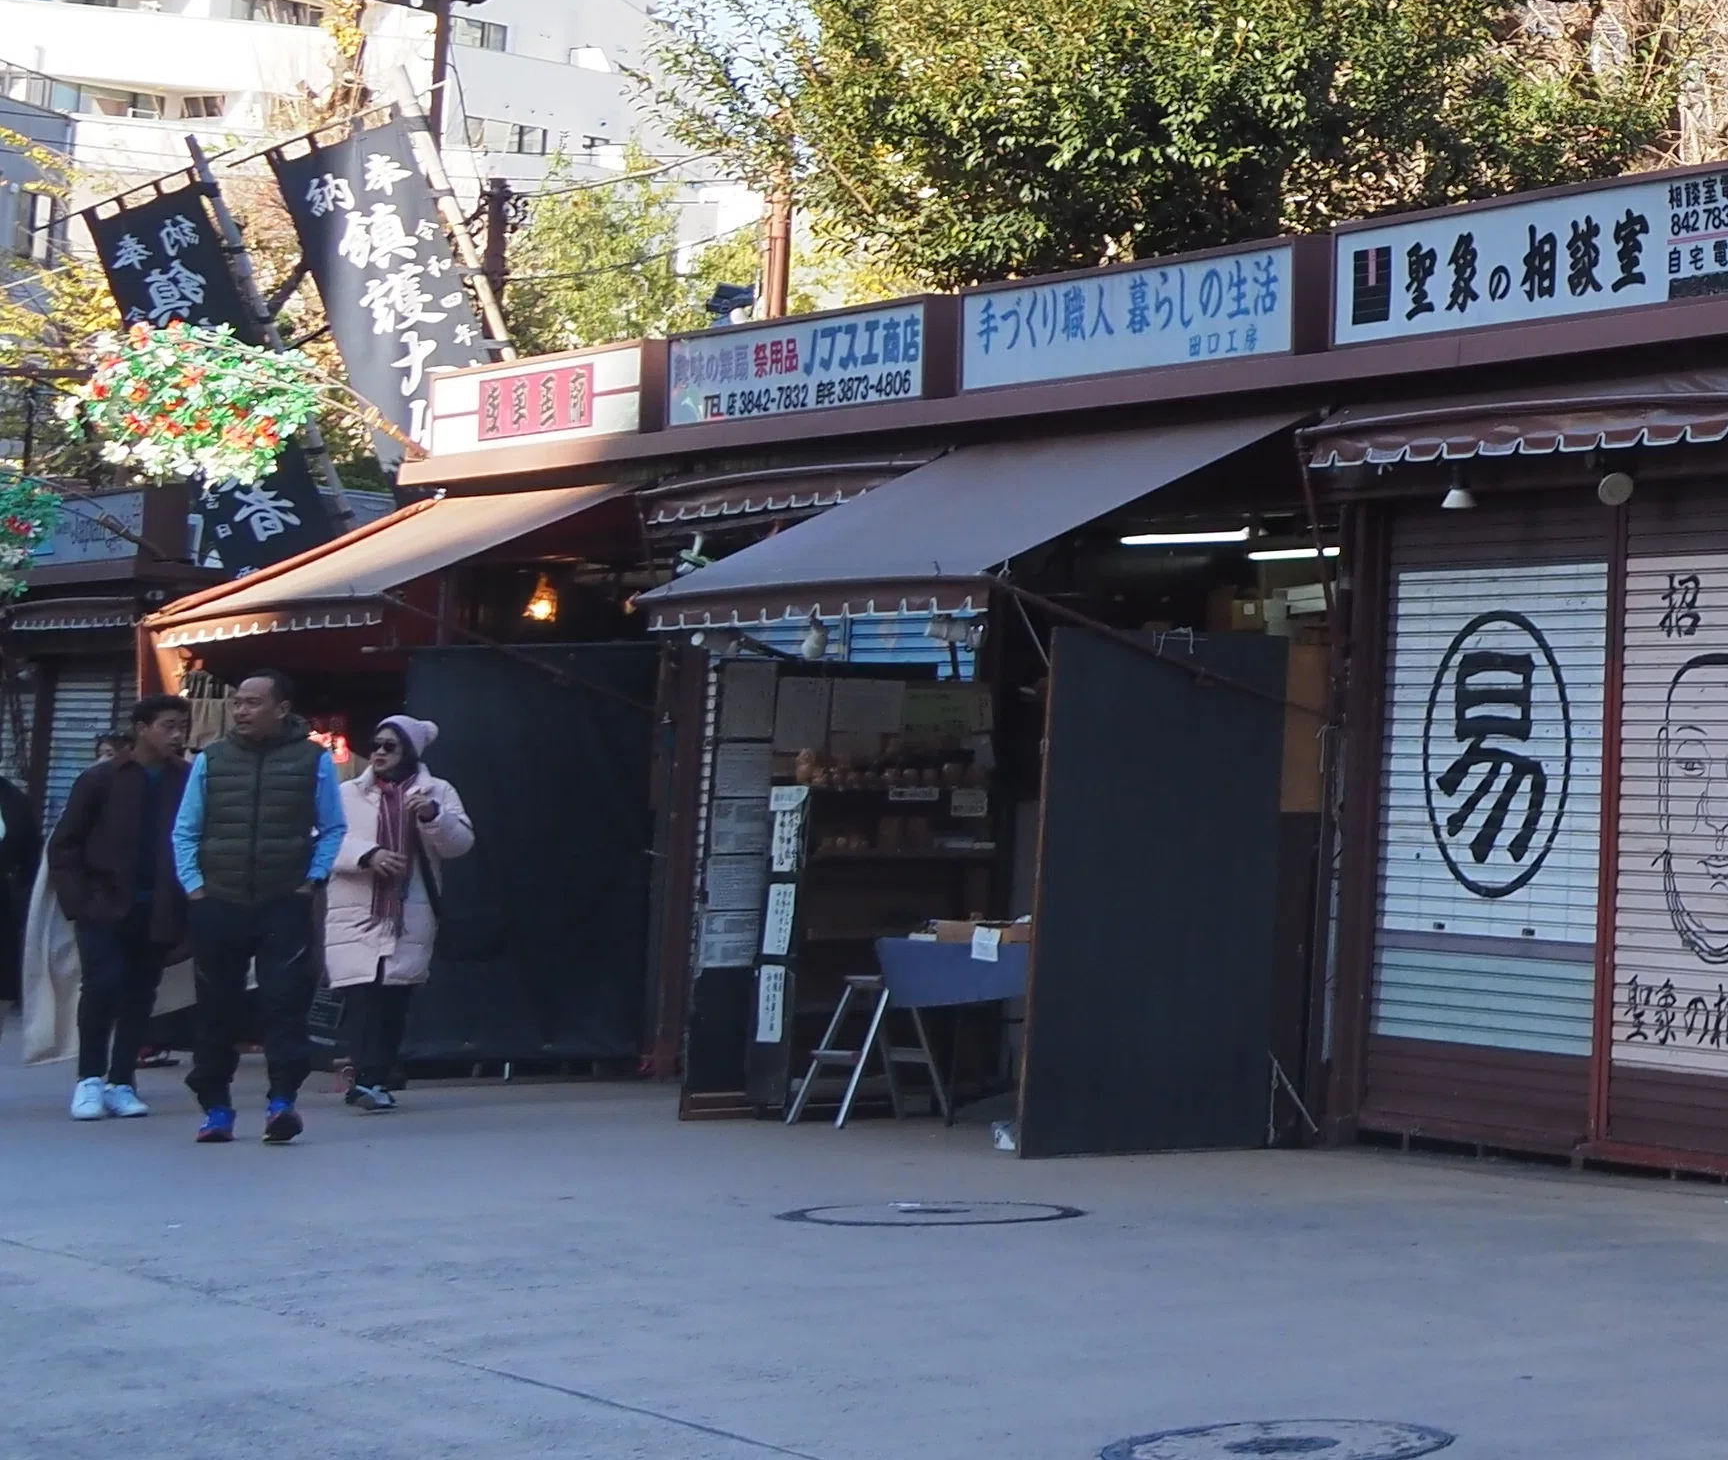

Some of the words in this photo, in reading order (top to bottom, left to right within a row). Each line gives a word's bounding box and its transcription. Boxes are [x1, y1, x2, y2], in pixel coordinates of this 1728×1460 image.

[1671, 212, 1699, 236] 842
[414, 218, 484, 368] 令和四年
[977, 283, 1115, 356] 手づくり職人
[1126, 254, 1280, 337] 暮らしの生活
[752, 337, 800, 379] 祭用品
[1188, 323, 1259, 357] 田口工房
